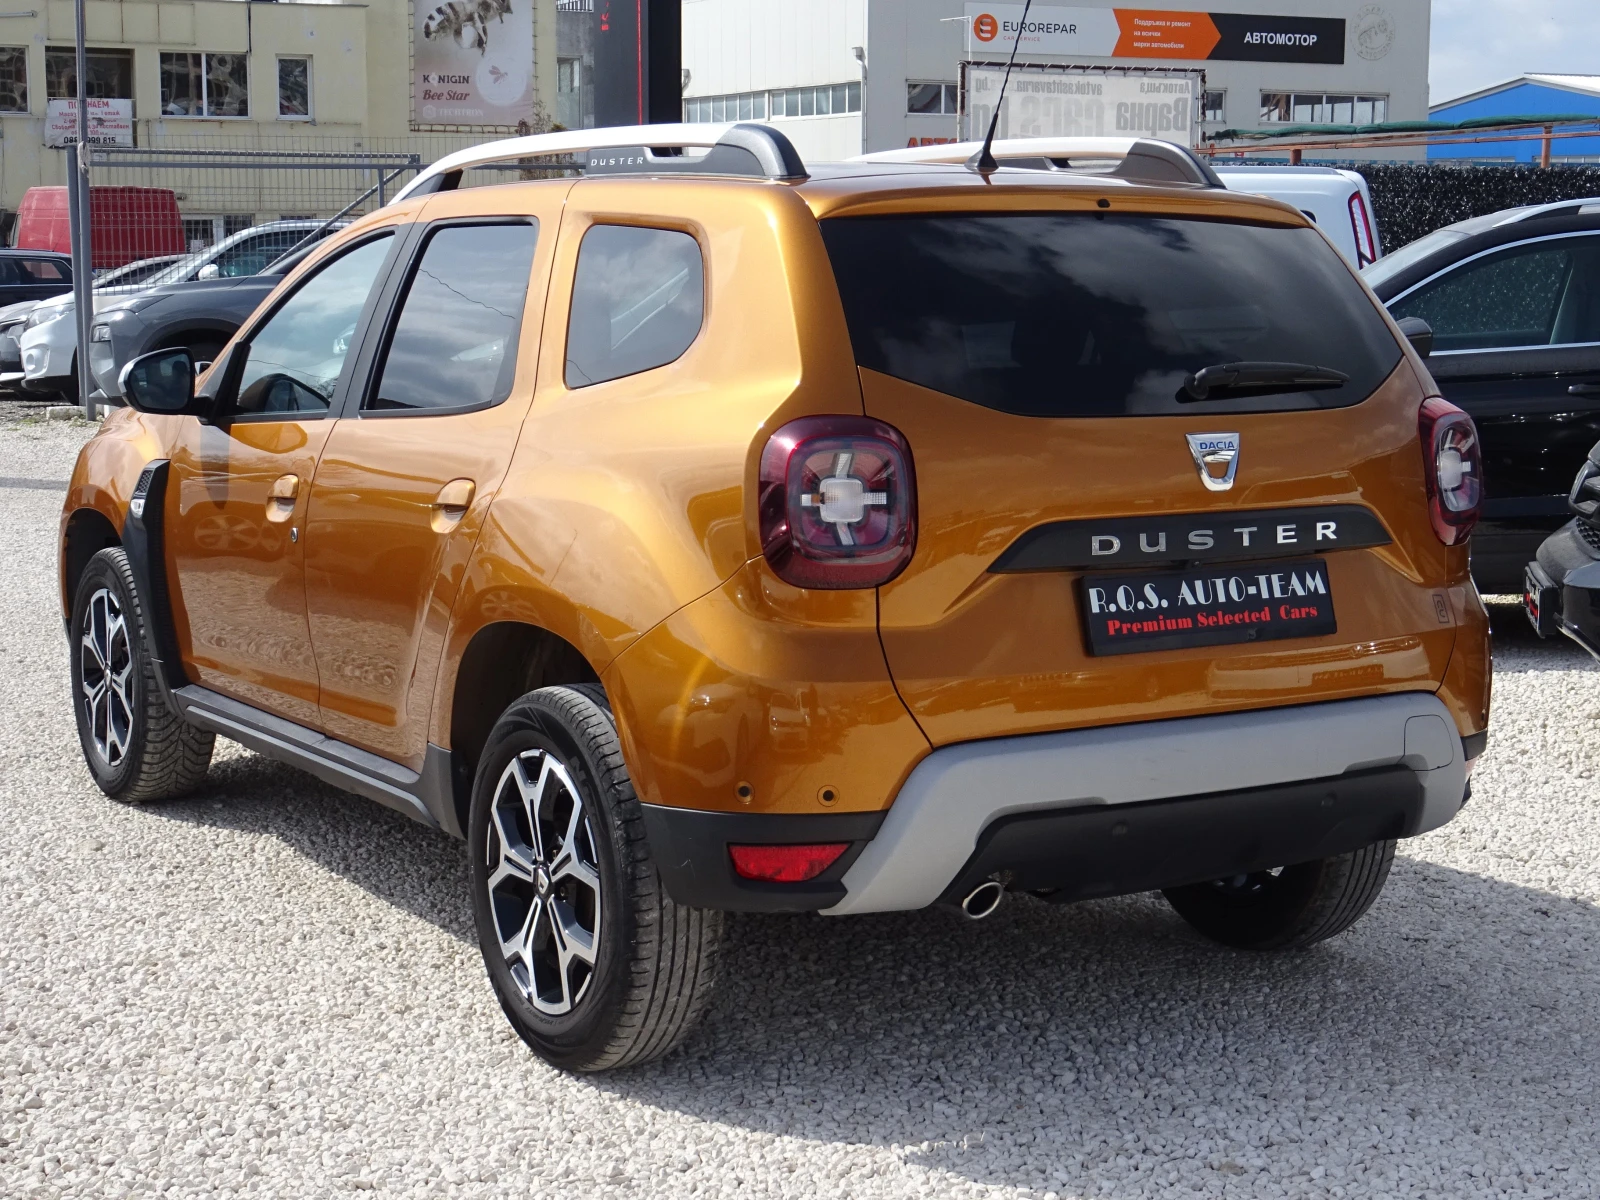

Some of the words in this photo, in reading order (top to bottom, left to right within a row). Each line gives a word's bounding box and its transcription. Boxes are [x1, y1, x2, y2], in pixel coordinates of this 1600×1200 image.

[1003, 21, 1077, 35] EUROREPAR
[1243, 32, 1318, 46] АВТОМОТОР
[422, 89, 444, 101] Bee
[445, 89, 471, 101] Star
[103, 136, 116, 144] 815
[590, 156, 644, 167] DUSTER
[1199, 441, 1235, 450] DACIA
[1091, 521, 1338, 556] DUSTER
[1088, 582, 1169, 614] R.Q.S.
[1177, 570, 1327, 607] AUTO-TEAM
[1106, 614, 1193, 636] Premium
[1197, 607, 1271, 628] Selected
[1279, 604, 1318, 621] Cars
